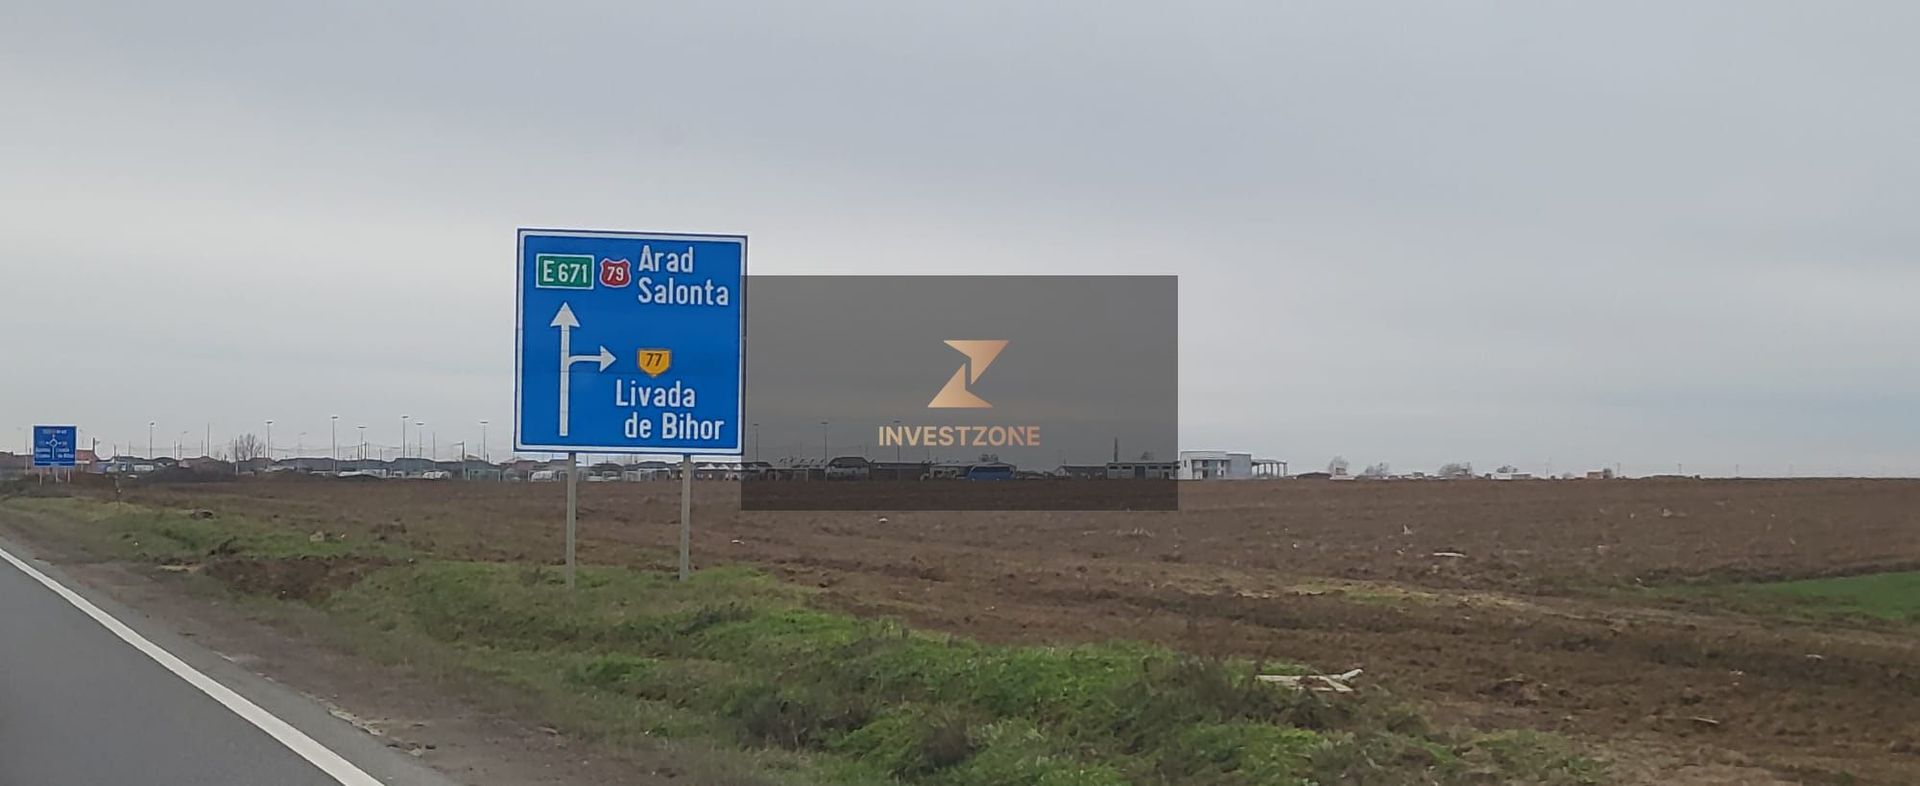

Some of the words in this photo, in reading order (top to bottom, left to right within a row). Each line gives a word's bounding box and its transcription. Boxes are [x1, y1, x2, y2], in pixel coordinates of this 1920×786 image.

[638, 245, 694, 273] Arad
[607, 266, 625, 282] 79
[638, 277, 729, 306] Salonta
[645, 353, 663, 367] 77
[616, 379, 696, 408] Livada
[624, 412, 652, 439] de
[662, 412, 725, 440] Bihor
